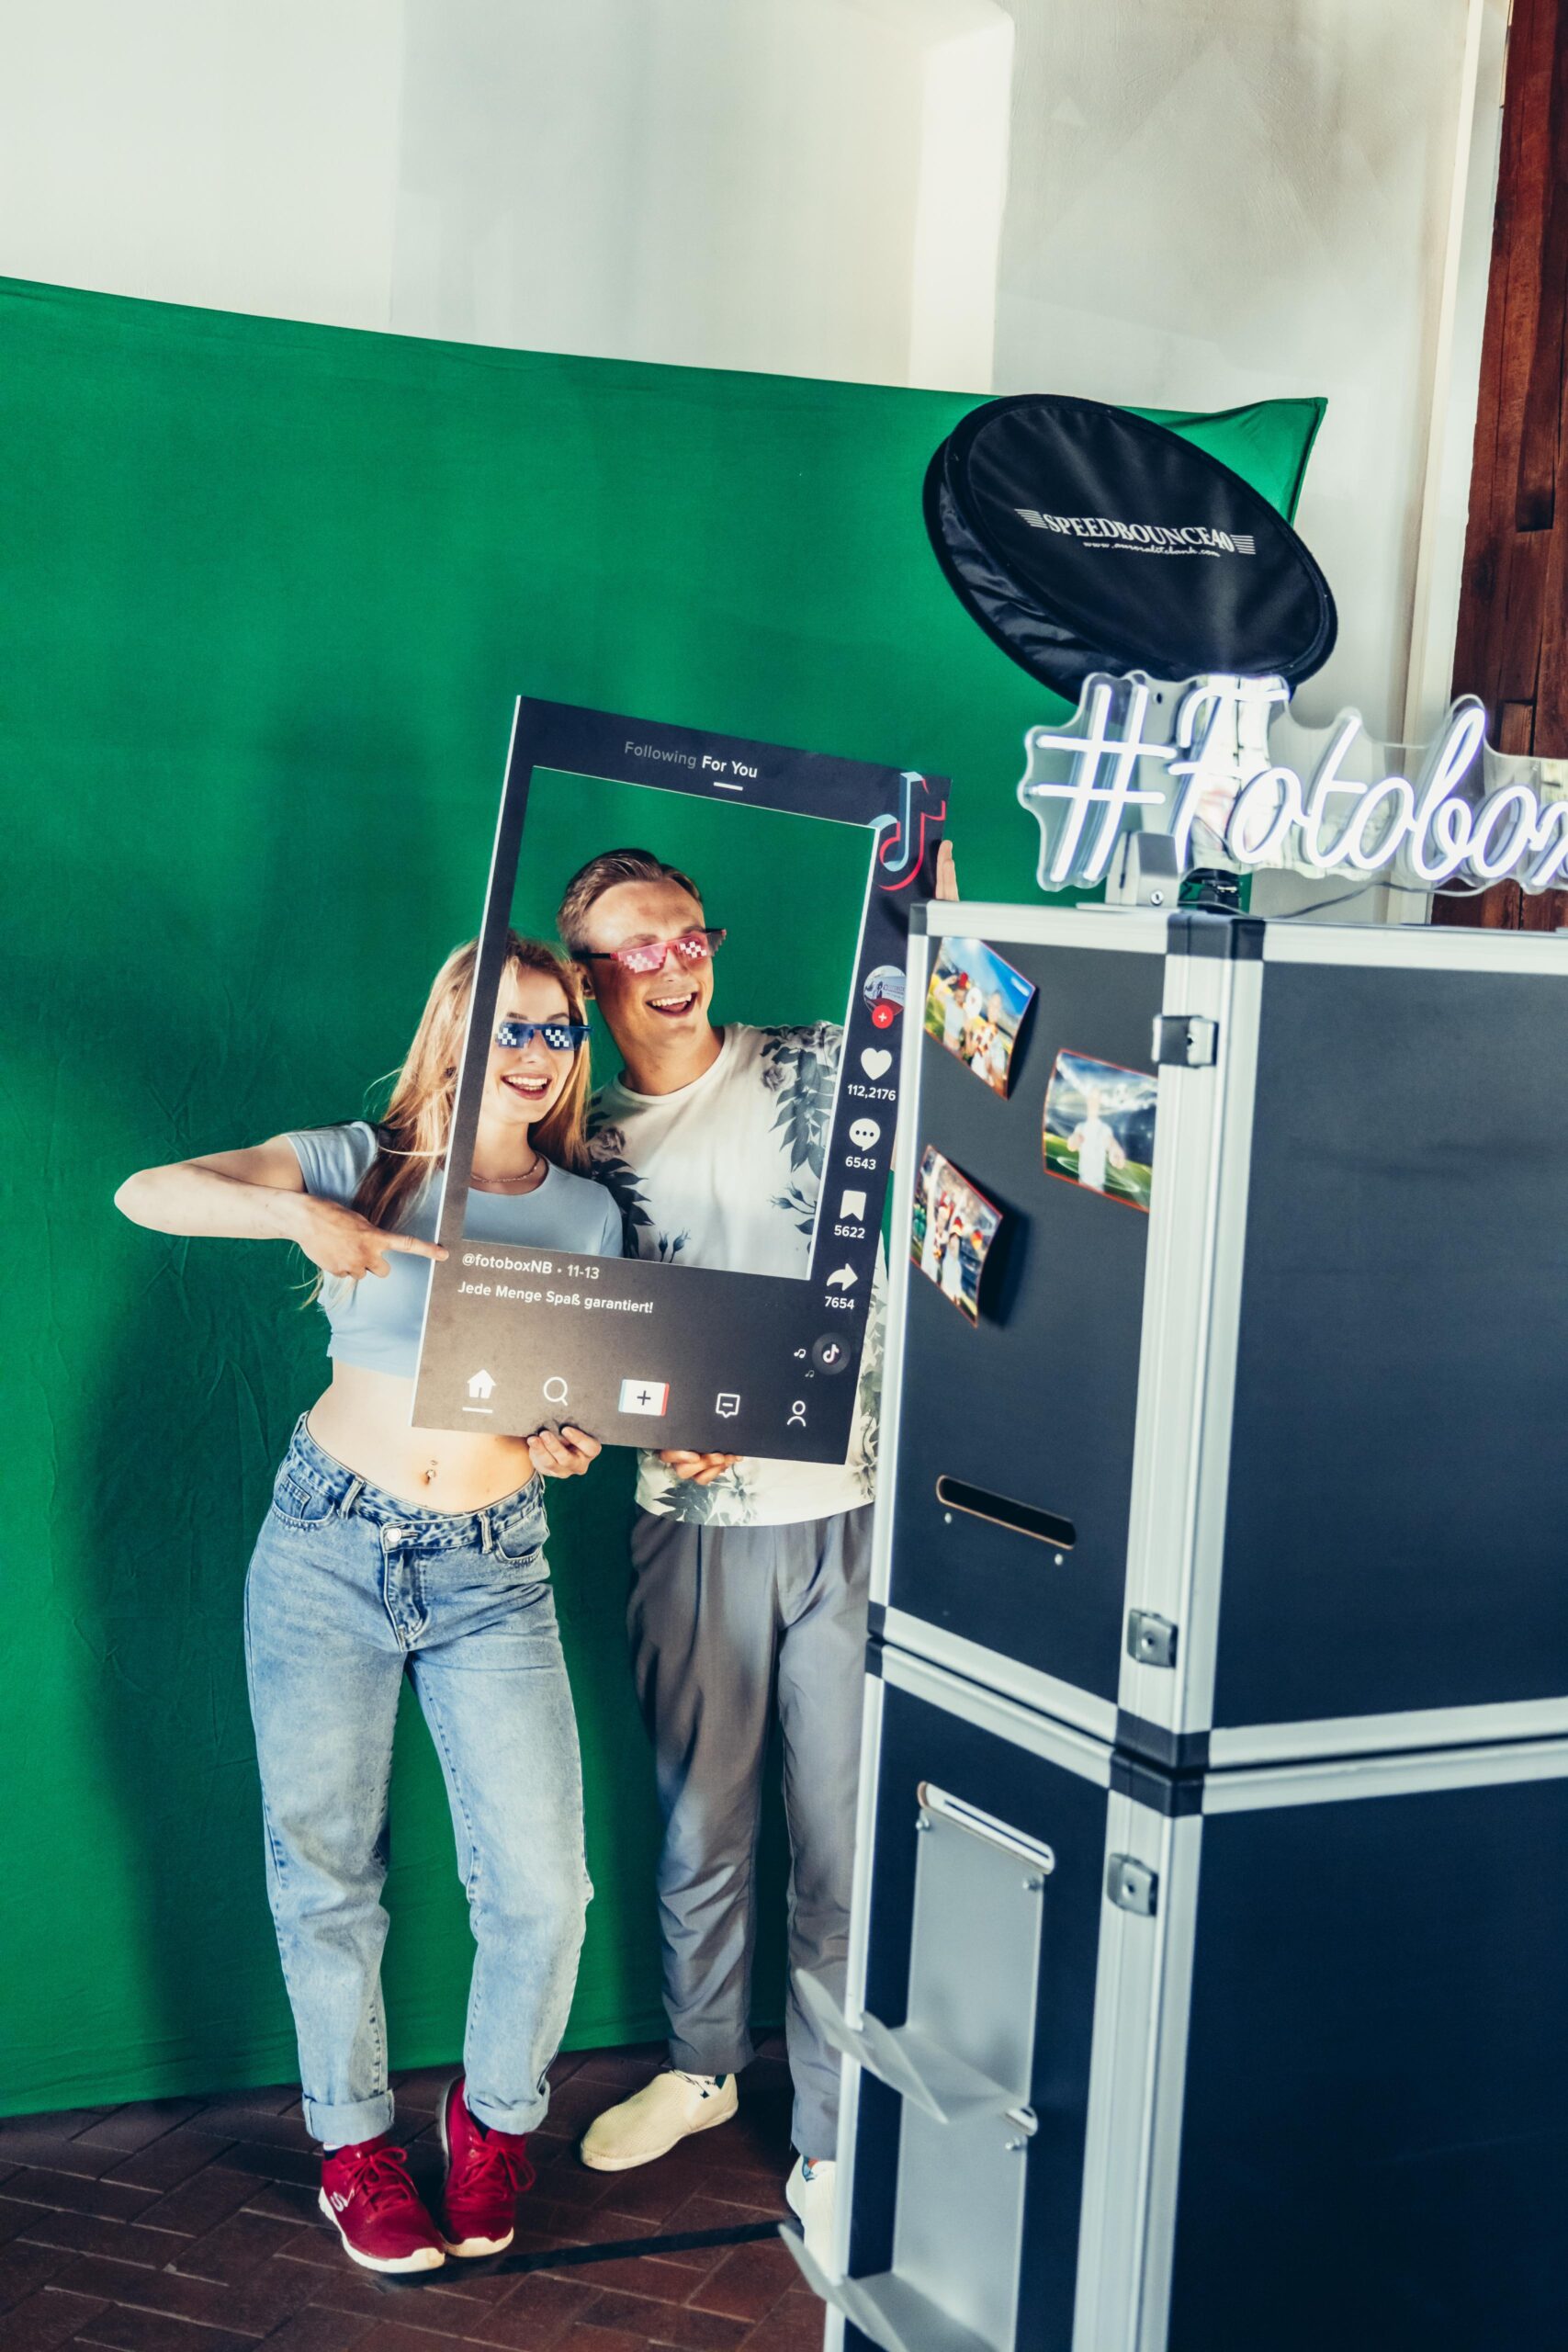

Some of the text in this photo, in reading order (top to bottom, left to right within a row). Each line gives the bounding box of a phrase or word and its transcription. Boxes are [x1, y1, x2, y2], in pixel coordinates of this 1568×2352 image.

[1043, 513, 1235, 553] SPEEDBOUNCE40
[624, 741, 759, 778] Following For You
[847, 1084, 897, 1102] 112,2176
[844, 1156, 876, 1170] 6543
[833, 1224, 866, 1239] 5622
[462, 1252, 601, 1280] @fotoboxNB 11-13
[457, 1281, 654, 1315] Jede Menge Spaß garantiert!
[824, 1295, 855, 1310] 7654
